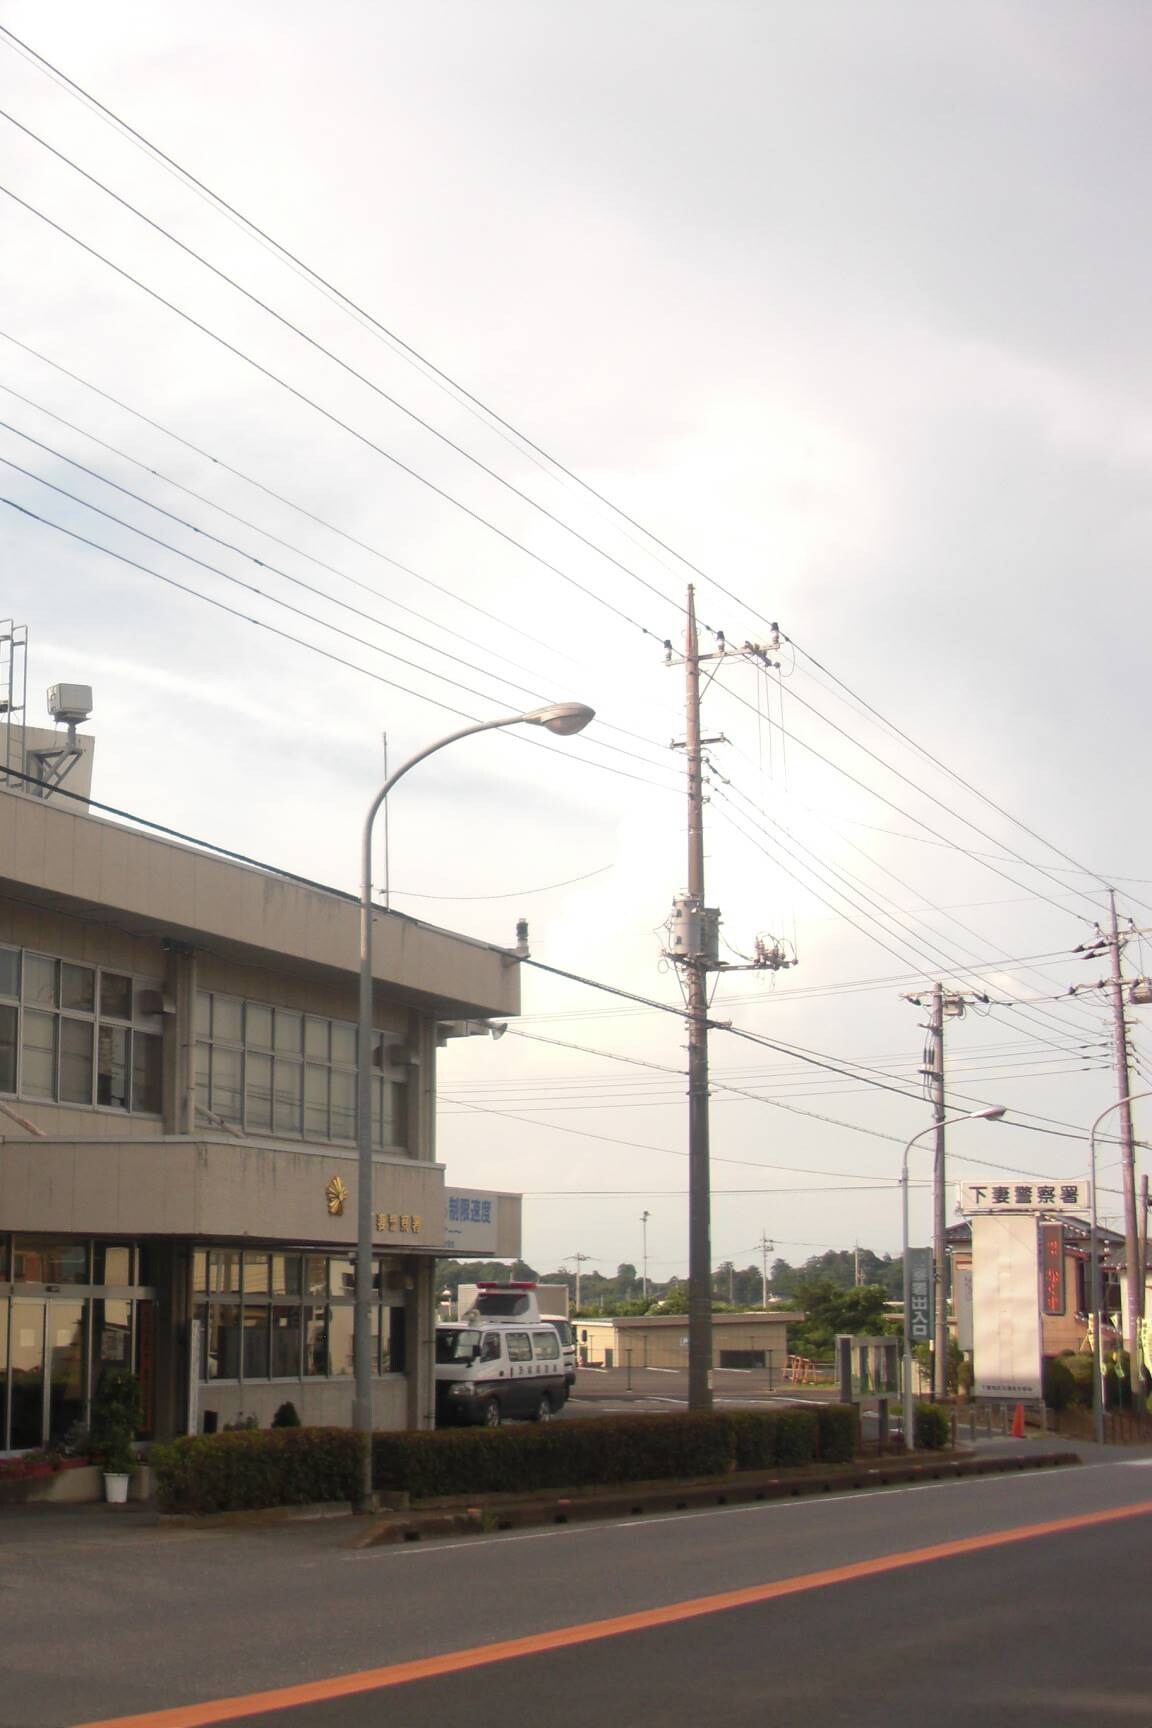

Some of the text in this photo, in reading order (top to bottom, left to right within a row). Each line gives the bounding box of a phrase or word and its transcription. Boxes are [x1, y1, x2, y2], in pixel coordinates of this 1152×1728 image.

[968, 1185, 1079, 1204] 下妻警察署
[448, 1197, 491, 1223] 制限速度
